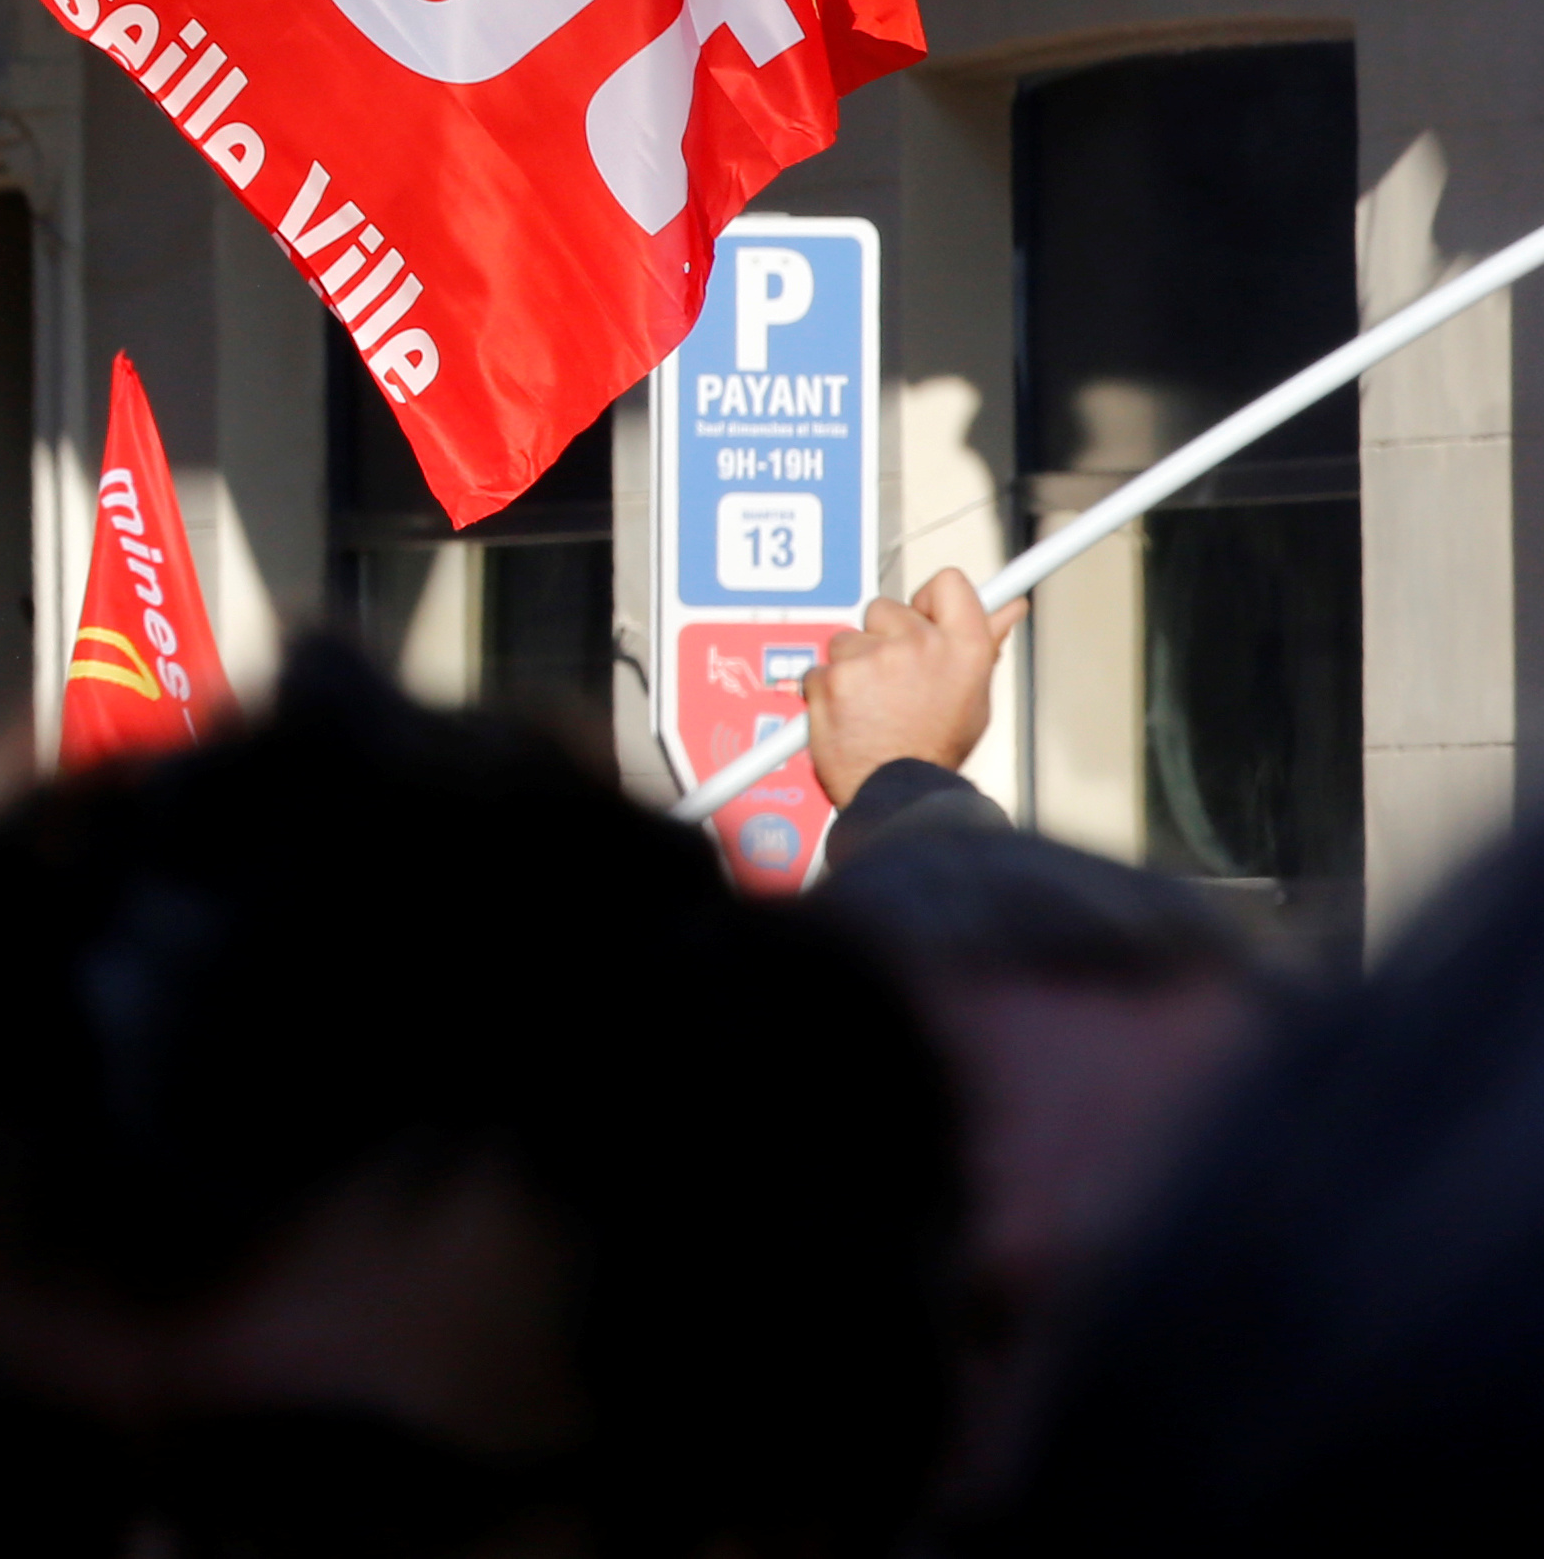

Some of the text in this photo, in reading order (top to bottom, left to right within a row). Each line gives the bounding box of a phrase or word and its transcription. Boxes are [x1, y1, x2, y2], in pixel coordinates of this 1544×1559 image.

[279, 162, 442, 403] Ville
[735, 247, 814, 372] P
[696, 374, 849, 418] PAYANT
[717, 447, 824, 482] 9H-19H
[744, 526, 795, 568] 13
